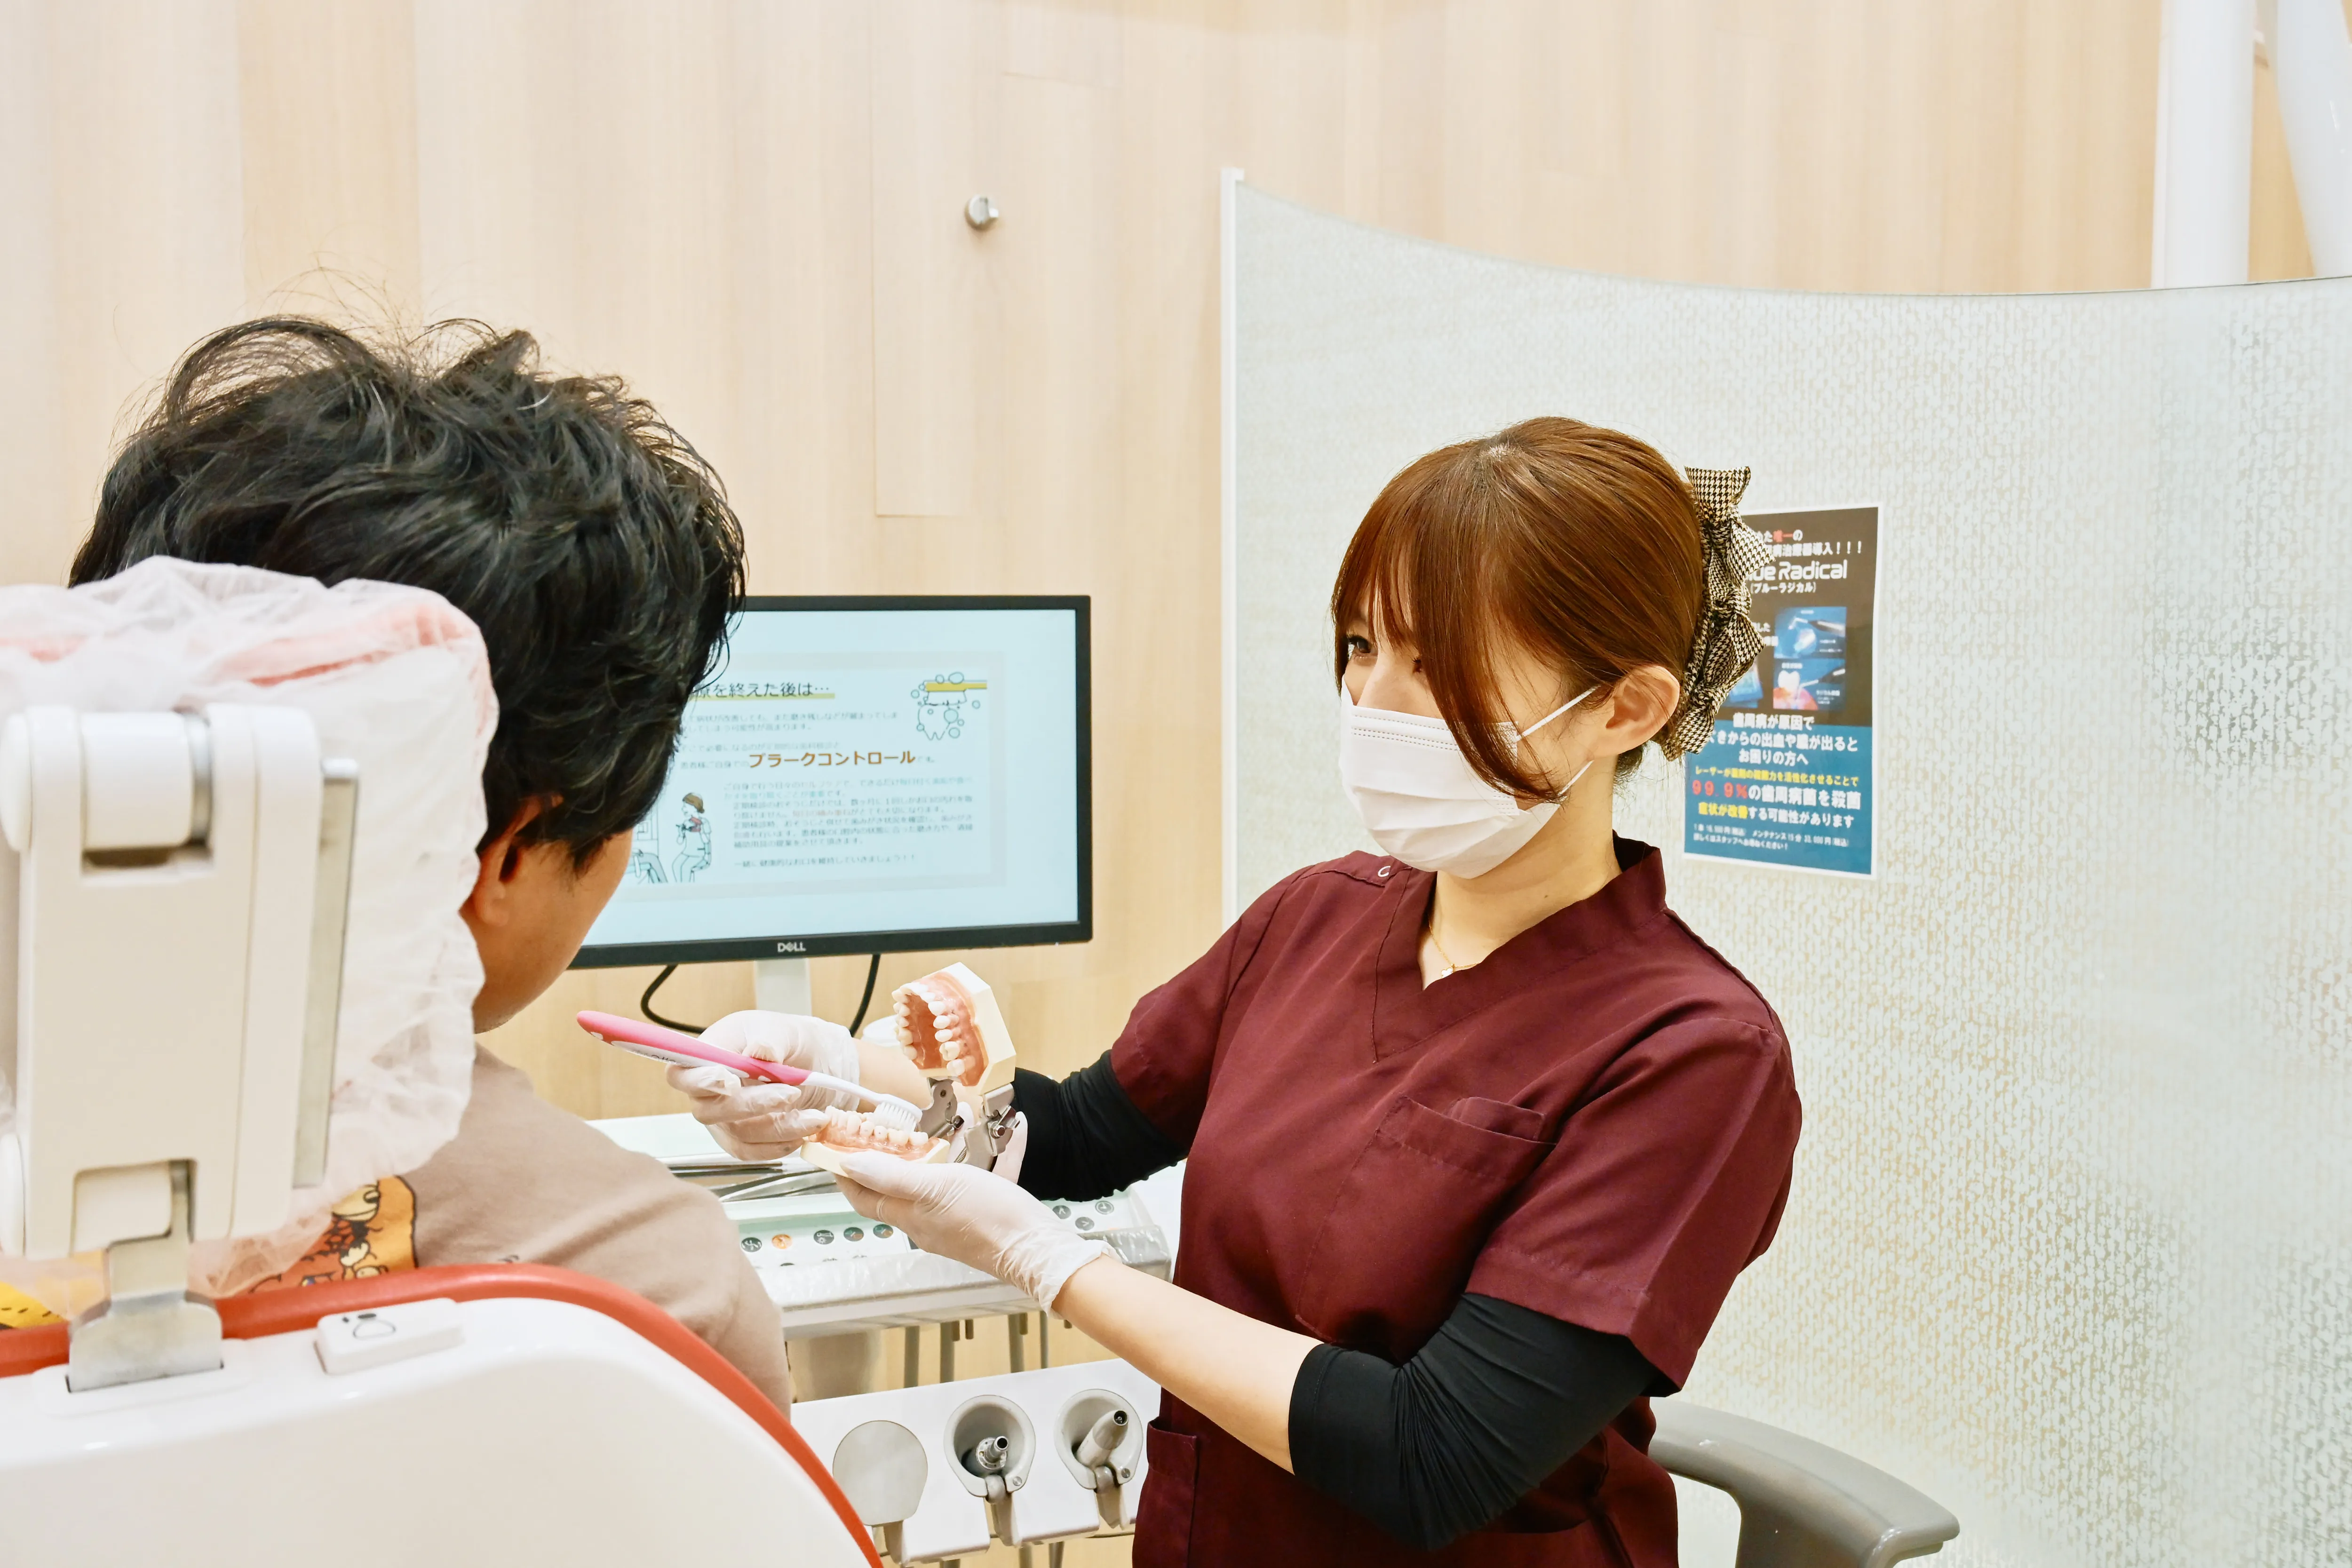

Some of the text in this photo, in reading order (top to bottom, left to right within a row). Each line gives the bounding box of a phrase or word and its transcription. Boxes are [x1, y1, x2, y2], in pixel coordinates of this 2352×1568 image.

[1779, 559, 1848, 581] Radical
[1733, 712, 1814, 731] 歯周病が原因で
[749, 750, 916, 768] プラークコントロール
[1739, 748, 1809, 766] お困りの方へ
[1698, 802, 1854, 828] 症状が改善する可能性があります
[777, 942, 806, 953] DELL
